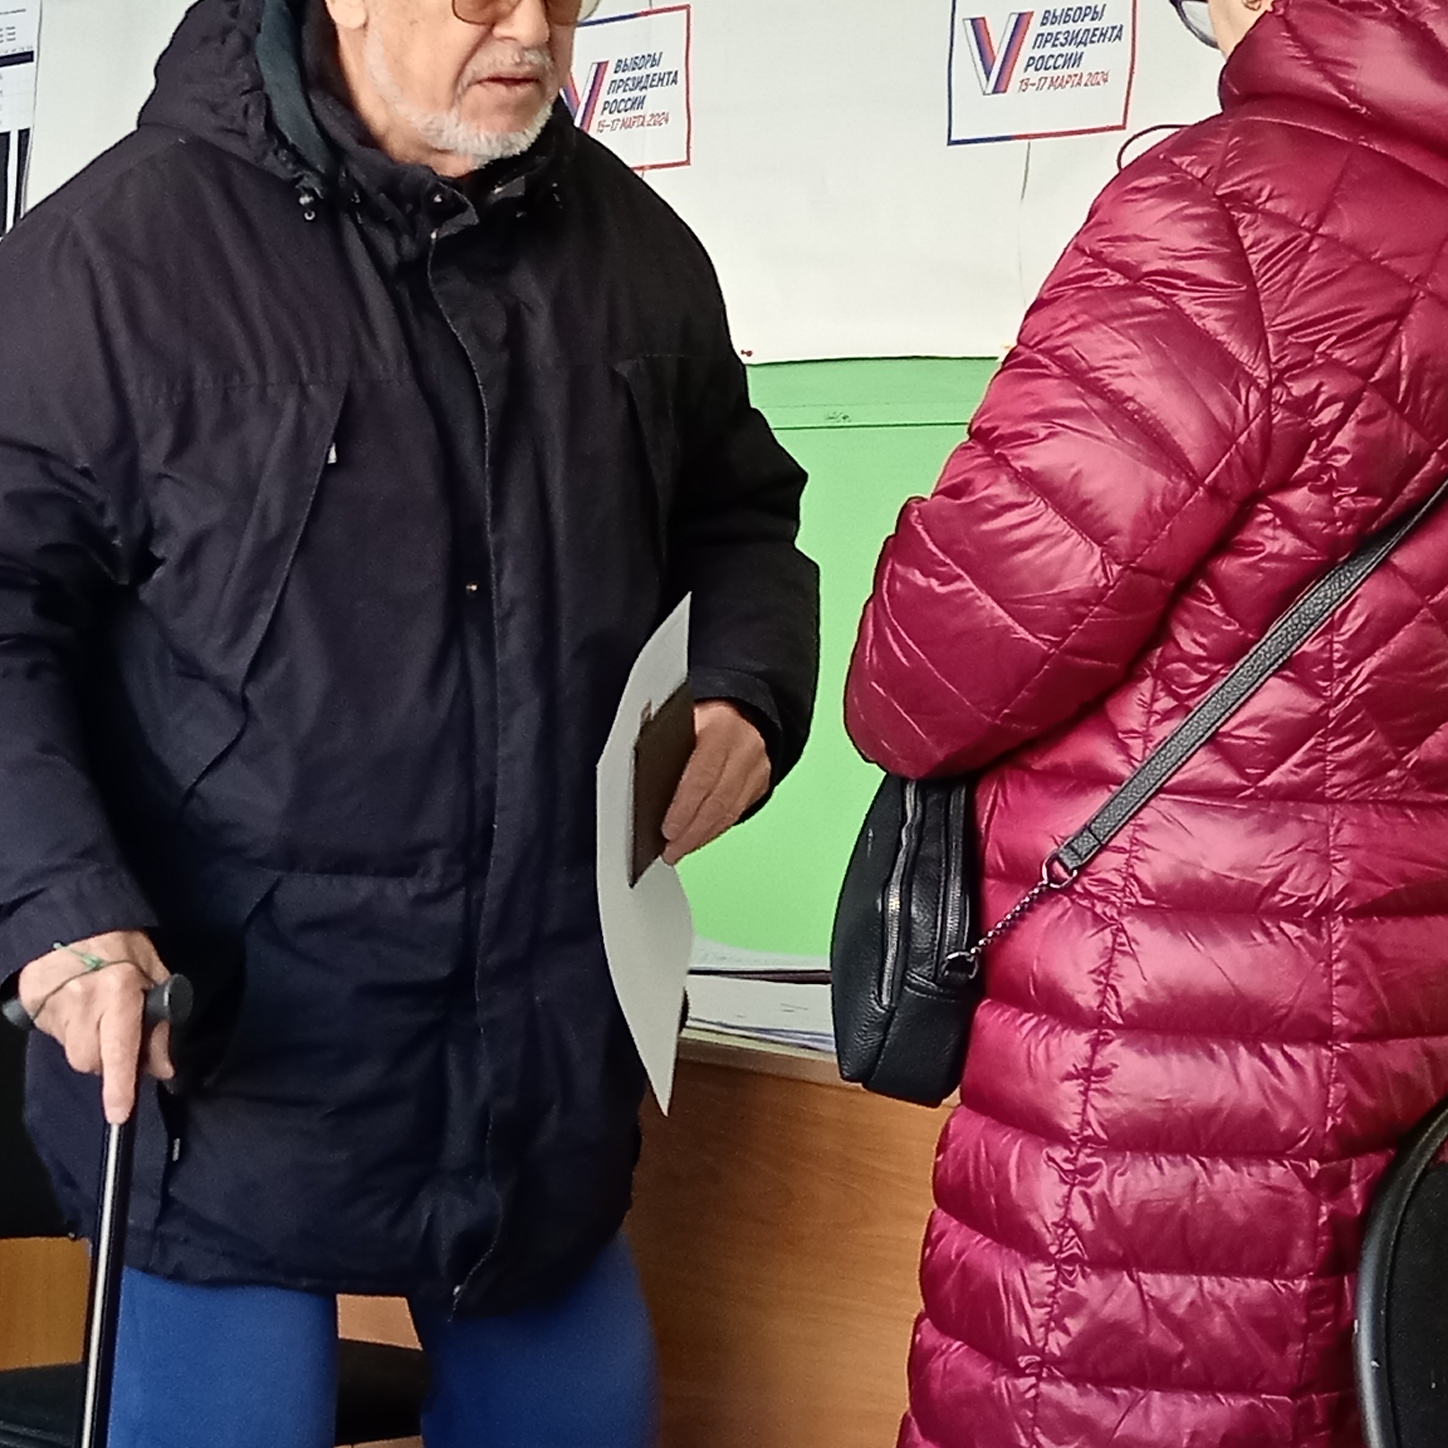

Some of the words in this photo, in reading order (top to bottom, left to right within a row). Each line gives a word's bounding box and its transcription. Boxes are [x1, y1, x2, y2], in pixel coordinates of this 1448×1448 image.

[1040, 4, 1107, 27] ВЫБОРЫ
[1032, 24, 1124, 50] ПРЕЗИДЕНТА
[613, 52, 663, 74] ВЫБОРЫ
[1023, 51, 1085, 73] РОССИИ
[606, 70, 679, 95] ПРЕЗИДЕНТА
[1047, 72, 1083, 91] МАРТА
[1083, 69, 1110, 87] 2024
[600, 94, 647, 115] РОССИИ
[620, 113, 645, 130] МАРТА
